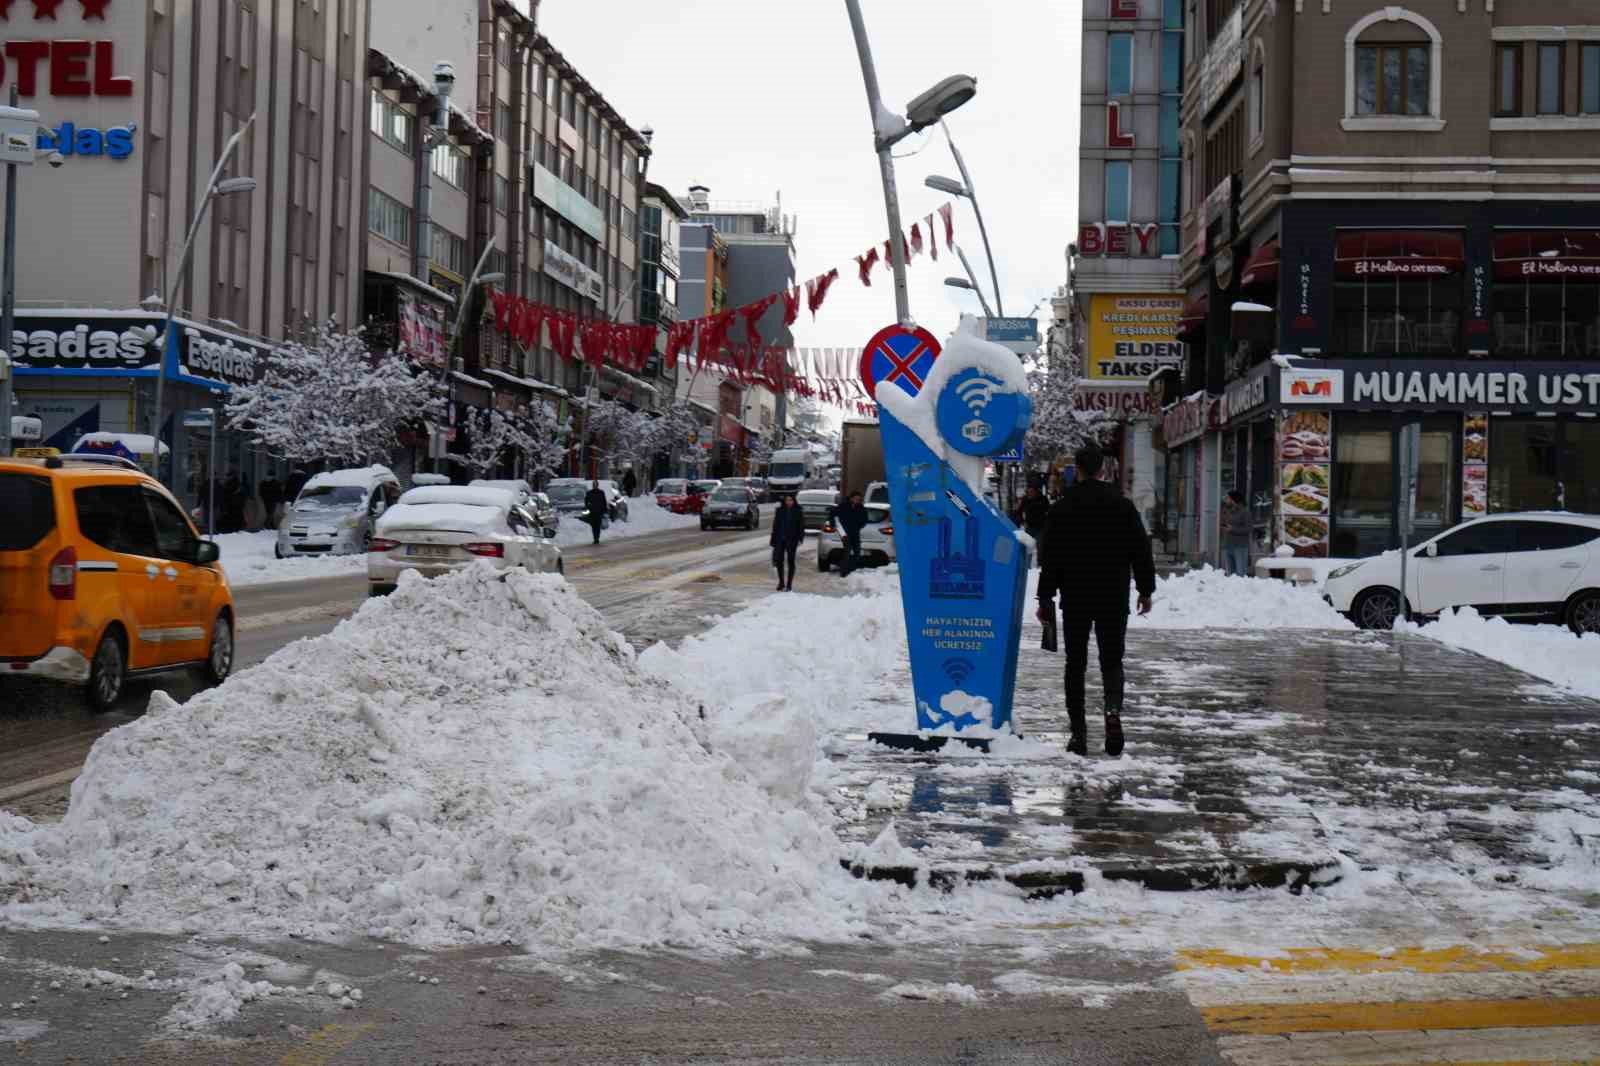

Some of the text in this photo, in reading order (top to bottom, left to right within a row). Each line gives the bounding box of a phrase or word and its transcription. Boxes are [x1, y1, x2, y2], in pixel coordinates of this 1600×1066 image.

[0, 41, 133, 97] TEL
[1078, 224, 1158, 256] BEY
[1354, 261, 1368, 273] El
[1371, 260, 1409, 272] Molino
[1522, 261, 1535, 274] El
[1538, 260, 1578, 273] Molino
[1116, 342, 1181, 356] ELDEN
[1353, 371, 1600, 404] MUAMMER UST
[922, 627, 941, 637] HER
